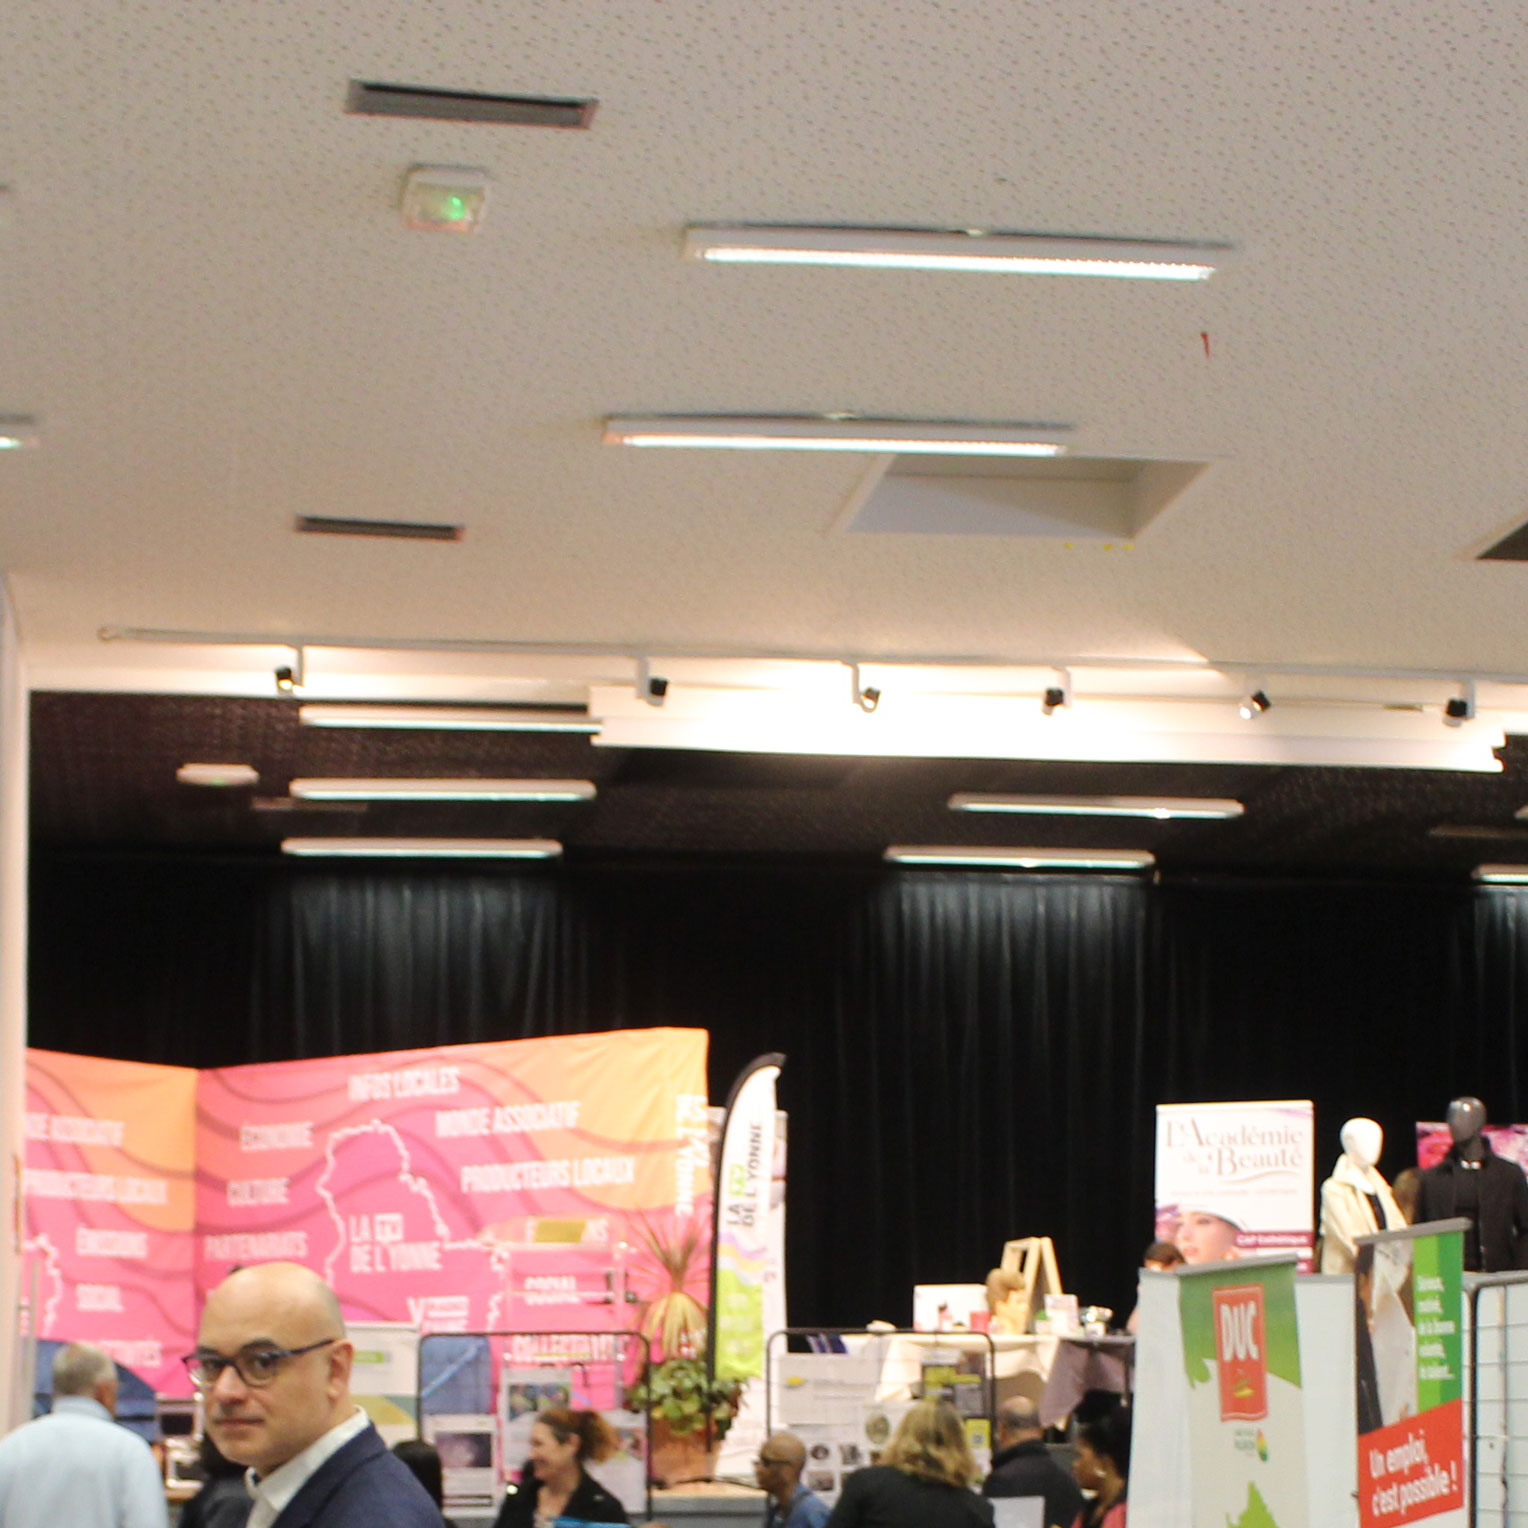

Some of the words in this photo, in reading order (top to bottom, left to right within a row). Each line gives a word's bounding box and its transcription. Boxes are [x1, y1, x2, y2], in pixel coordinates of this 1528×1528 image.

[1166, 1117, 1305, 1149] L'Académie
[1212, 1147, 1305, 1177] Beauté
[1219, 1300, 1260, 1363] DUC
[1369, 1449, 1386, 1479] Un
[1386, 1429, 1430, 1476] emploi,
[1372, 1482, 1400, 1517] c'est
[1400, 1464, 1451, 1516] possible
